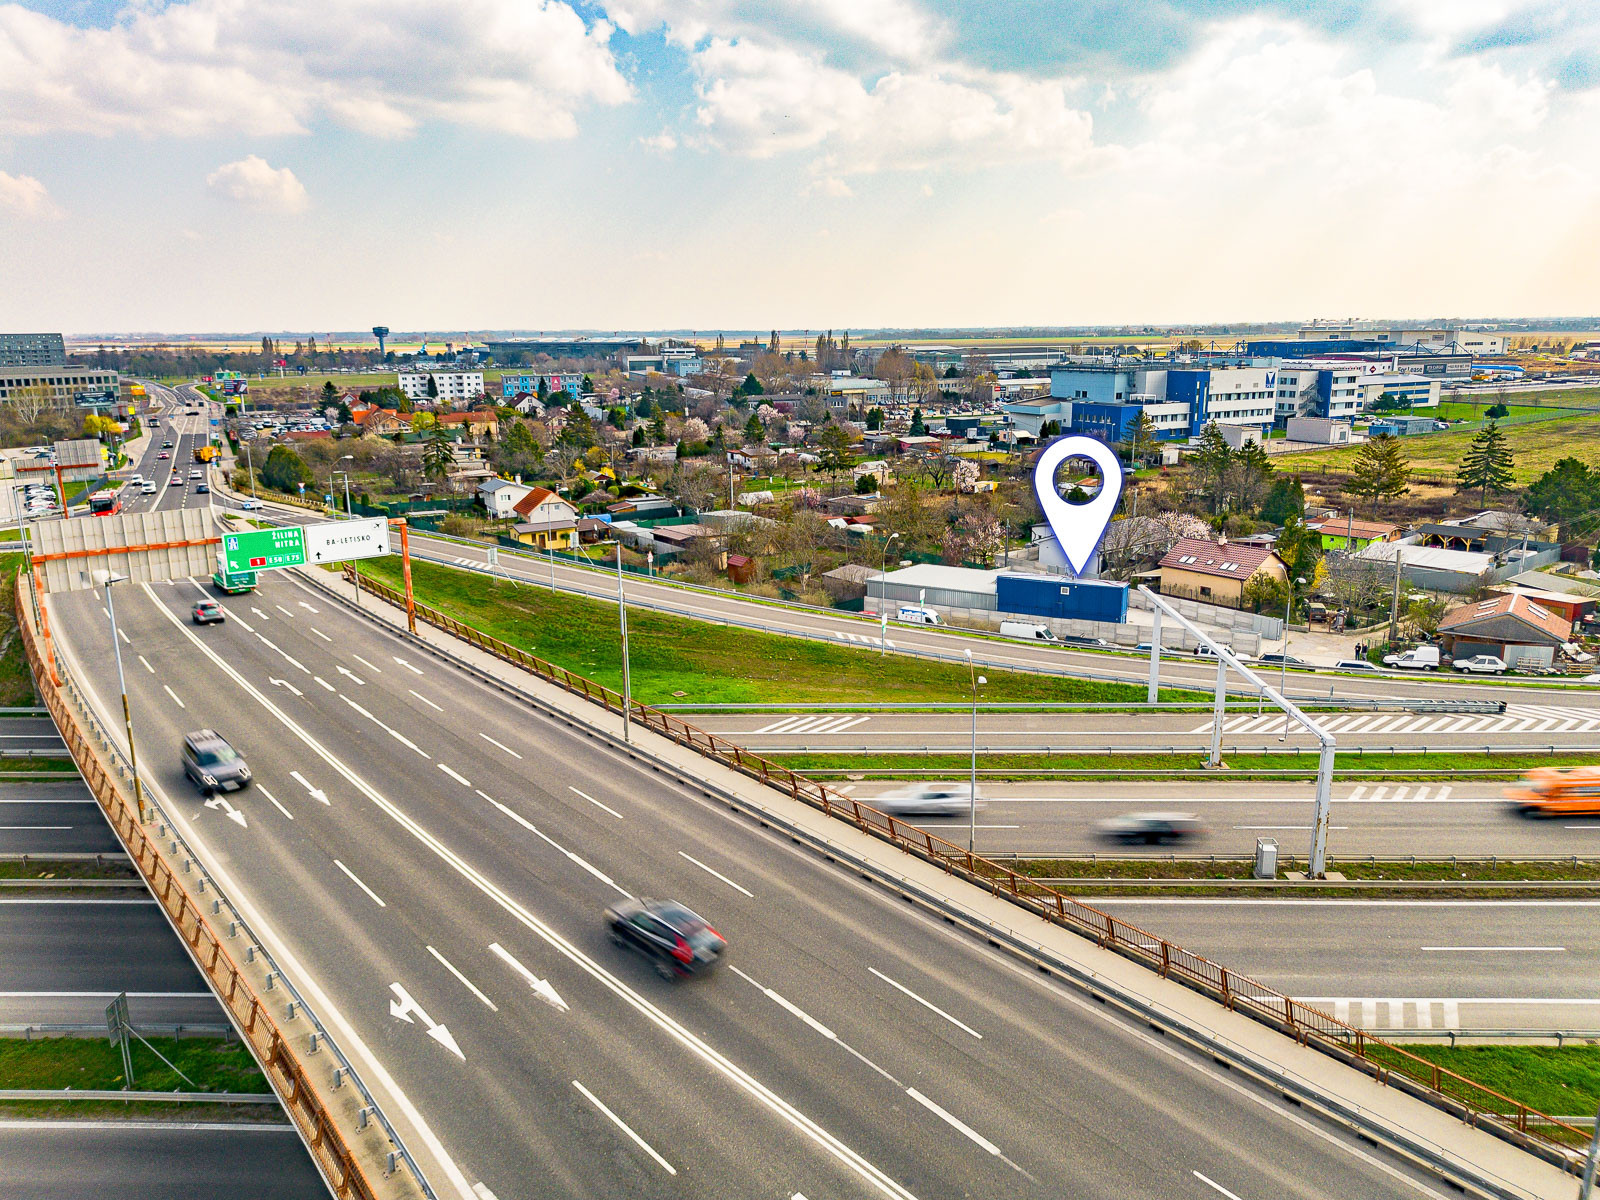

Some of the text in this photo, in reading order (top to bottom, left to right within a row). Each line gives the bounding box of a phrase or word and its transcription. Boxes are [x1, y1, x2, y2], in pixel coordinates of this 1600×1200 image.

[271, 531, 299, 540] ŽILINA
[326, 534, 371, 546] BA-LETISKO
[275, 540, 300, 549] NITRA
[291, 554, 300, 562] 75
